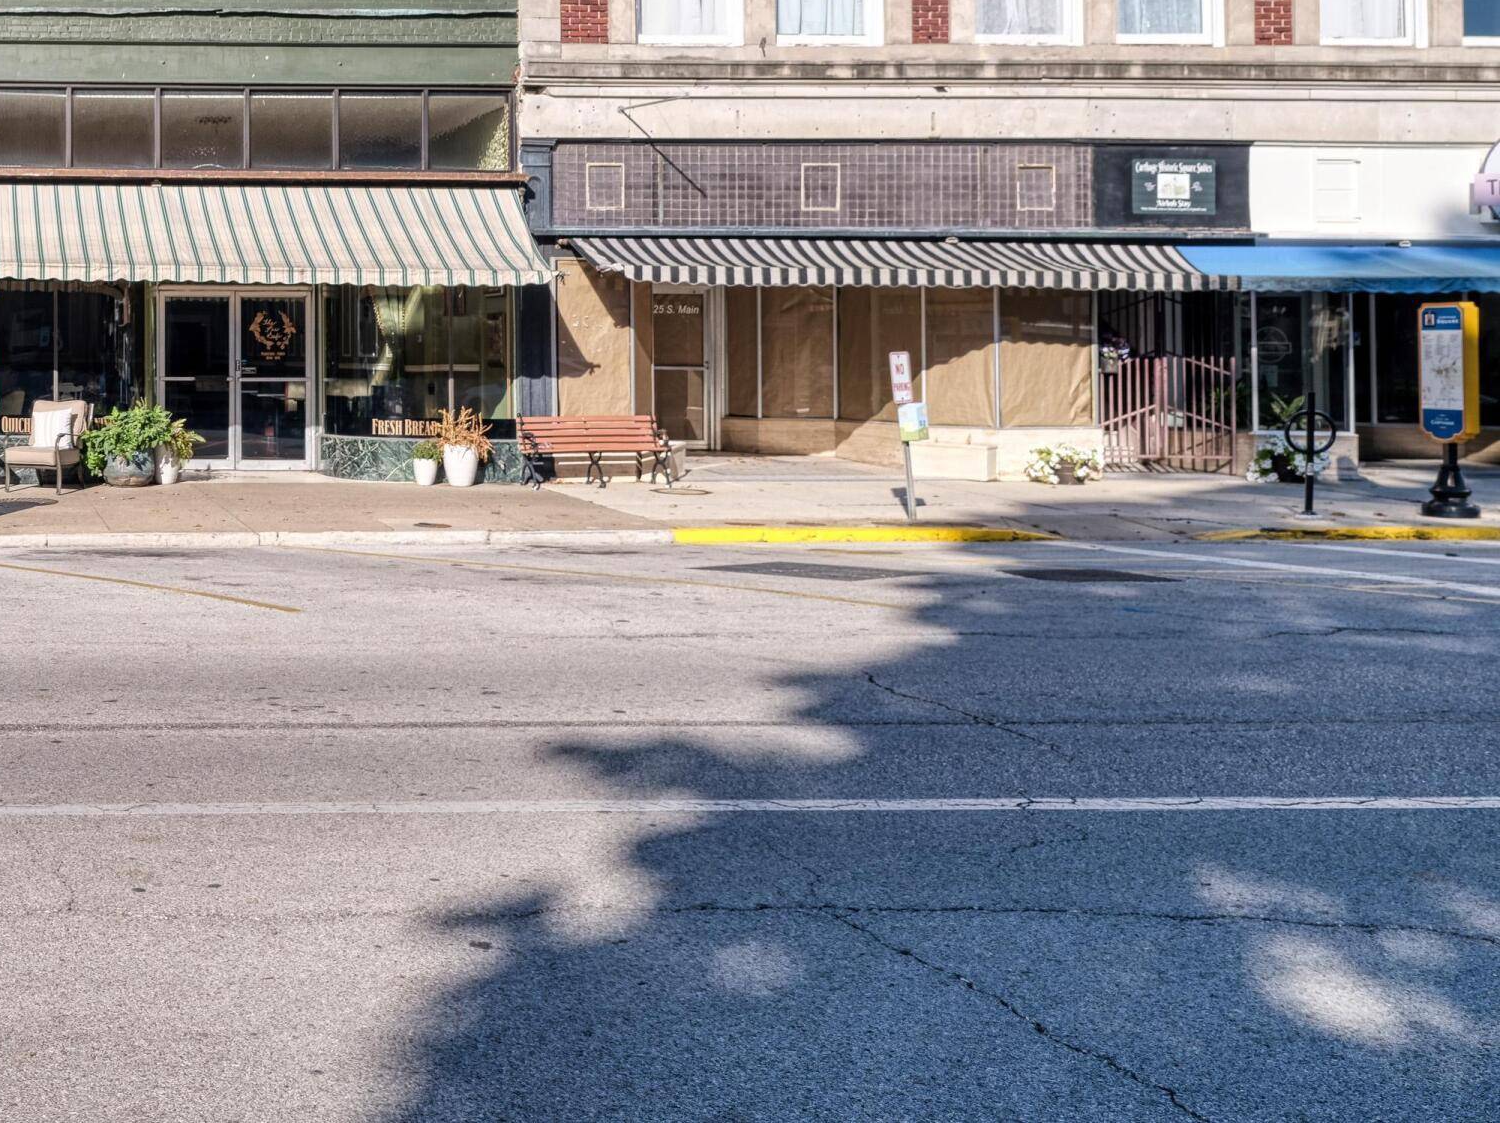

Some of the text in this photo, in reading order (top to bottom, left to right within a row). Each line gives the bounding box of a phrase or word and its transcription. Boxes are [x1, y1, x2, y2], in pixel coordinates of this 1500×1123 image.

[666, 304, 676, 314] S.
[678, 304, 700, 315] Main
[893, 363, 905, 375] NO
[1, 416, 32, 433] QUICH
[371, 418, 439, 436] FRESH BREAD
